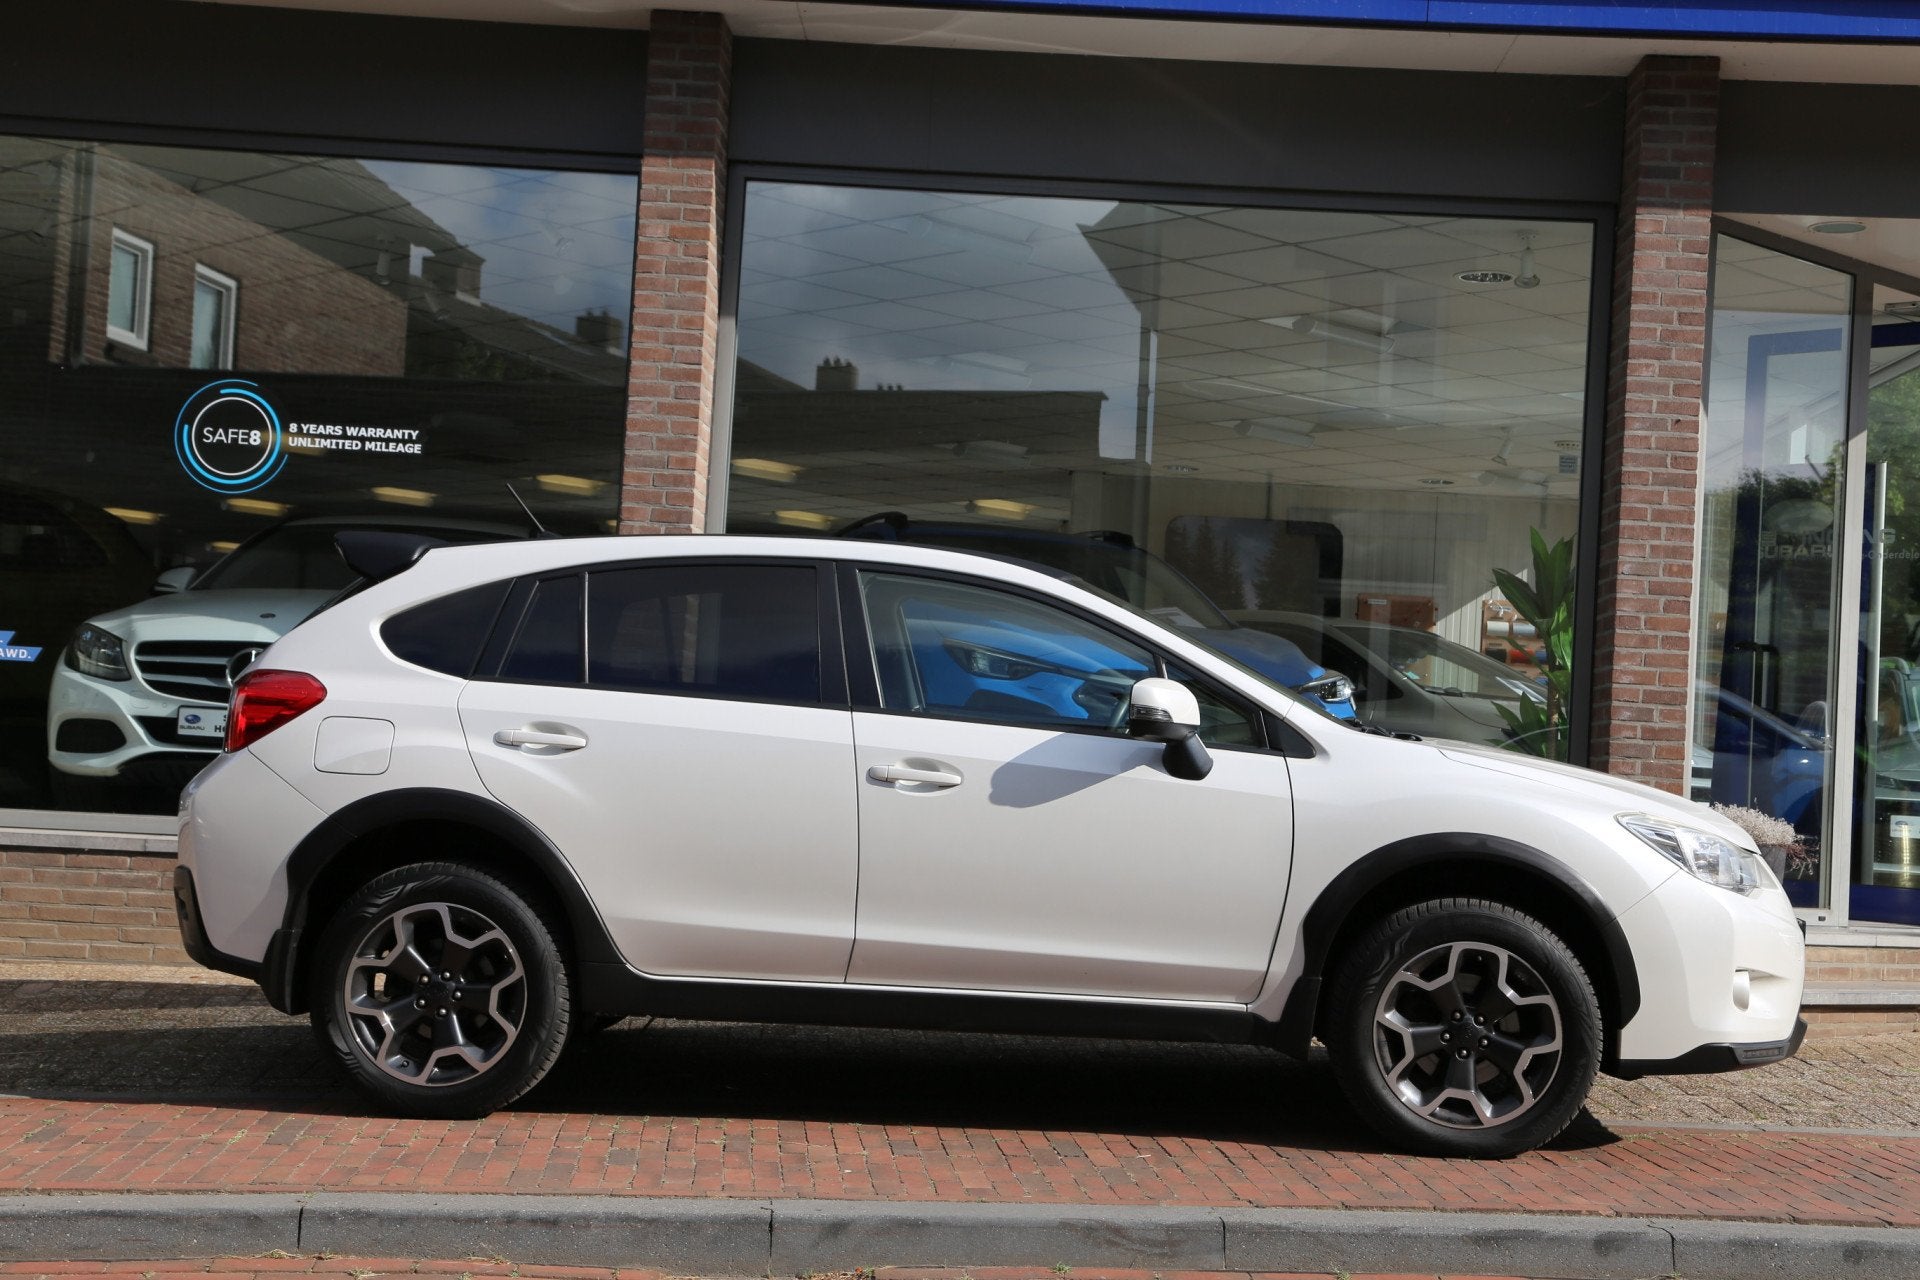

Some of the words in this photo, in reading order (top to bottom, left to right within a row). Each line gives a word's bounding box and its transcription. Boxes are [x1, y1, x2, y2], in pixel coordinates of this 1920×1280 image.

[203, 427, 261, 446] SAFE8
[289, 423, 298, 433] 8
[301, 424, 343, 436] YEARS
[345, 426, 419, 440] WARRANTY
[288, 437, 362, 451] UNLIMITED
[364, 441, 422, 454] MILEAGE
